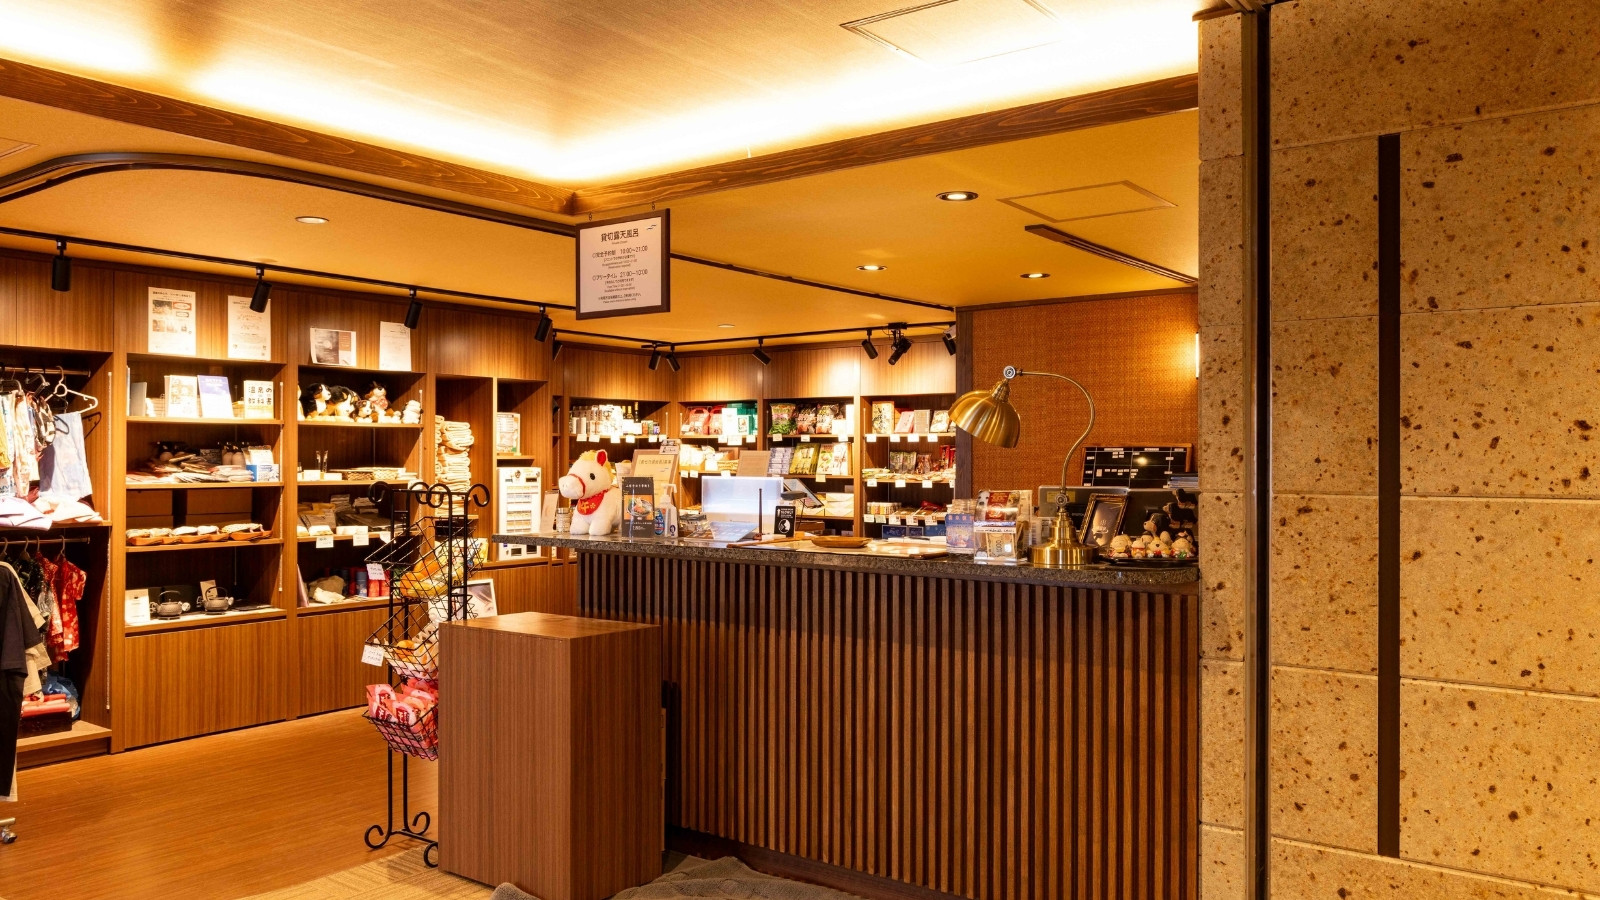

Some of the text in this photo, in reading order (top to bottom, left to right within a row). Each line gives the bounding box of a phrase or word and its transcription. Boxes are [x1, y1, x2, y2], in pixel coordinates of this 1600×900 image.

[600, 228, 639, 242] 貸切露天風呂
[248, 386, 272, 394] 温泉の
[248, 397, 272, 405] 教科書
